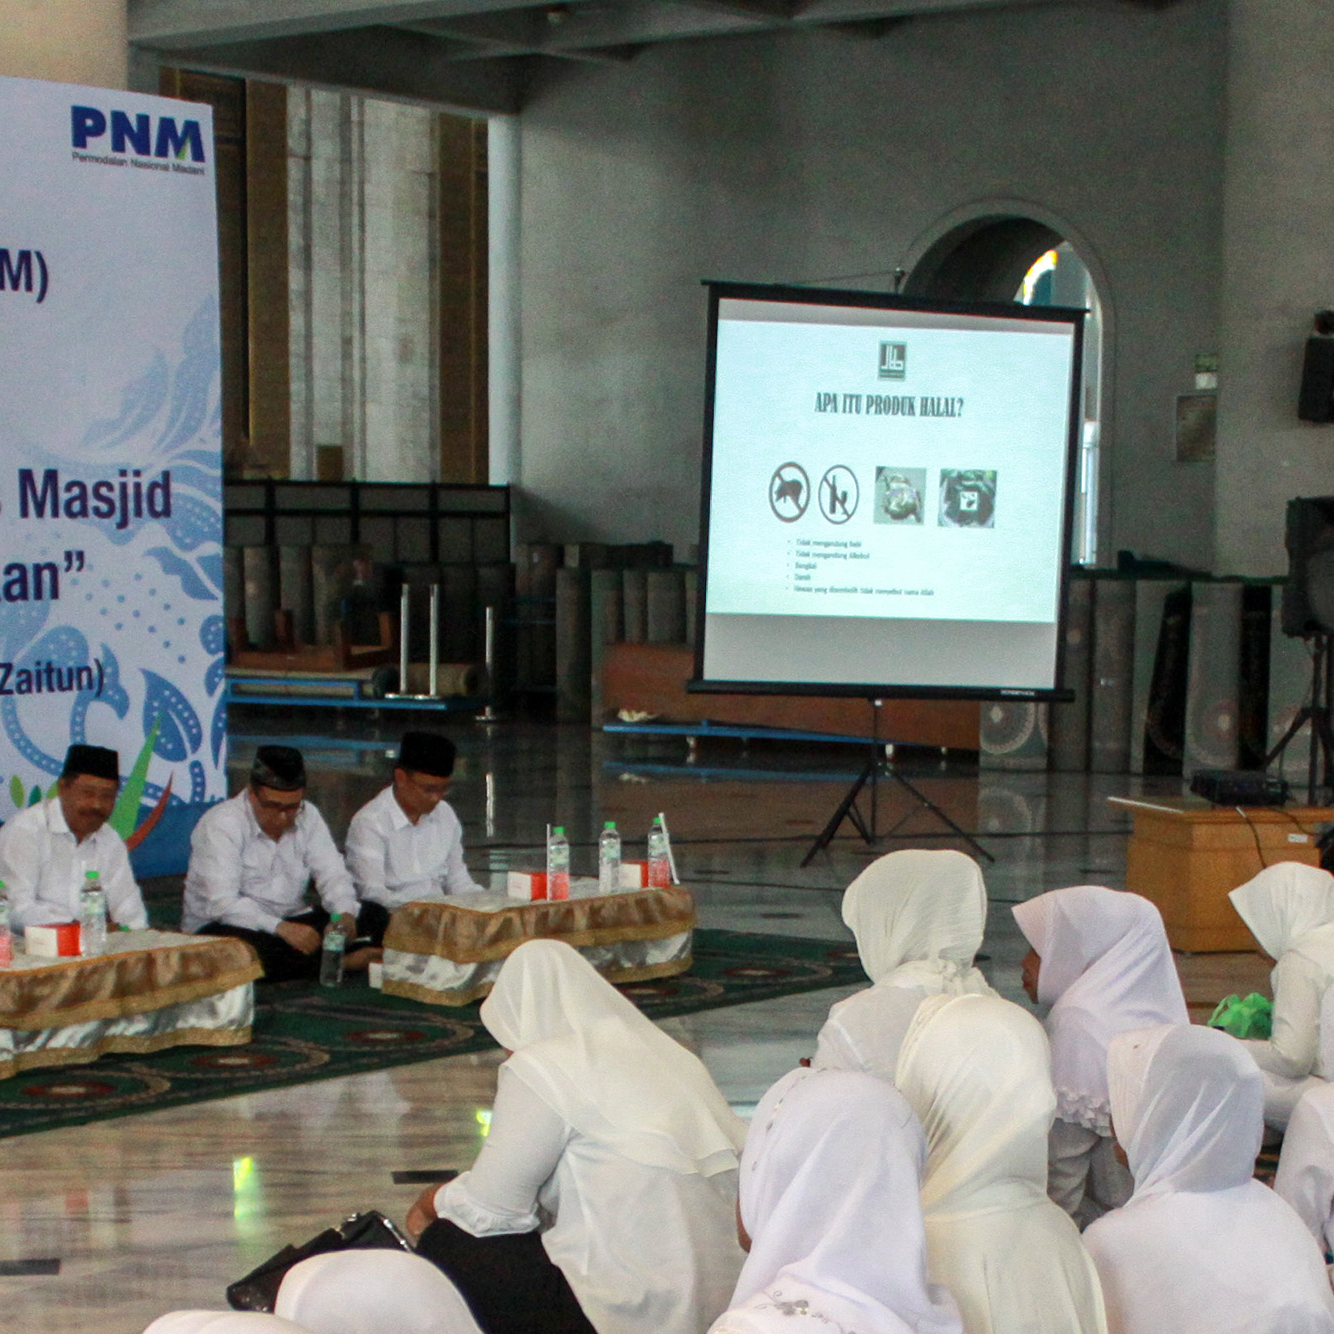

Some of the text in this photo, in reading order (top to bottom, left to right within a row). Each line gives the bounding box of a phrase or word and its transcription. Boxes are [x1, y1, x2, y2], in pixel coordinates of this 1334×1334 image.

[71, 105, 206, 163] PNM
[815, 393, 964, 417] APA ITU PRODUK HALAL?
[18, 468, 172, 531] Masjid
